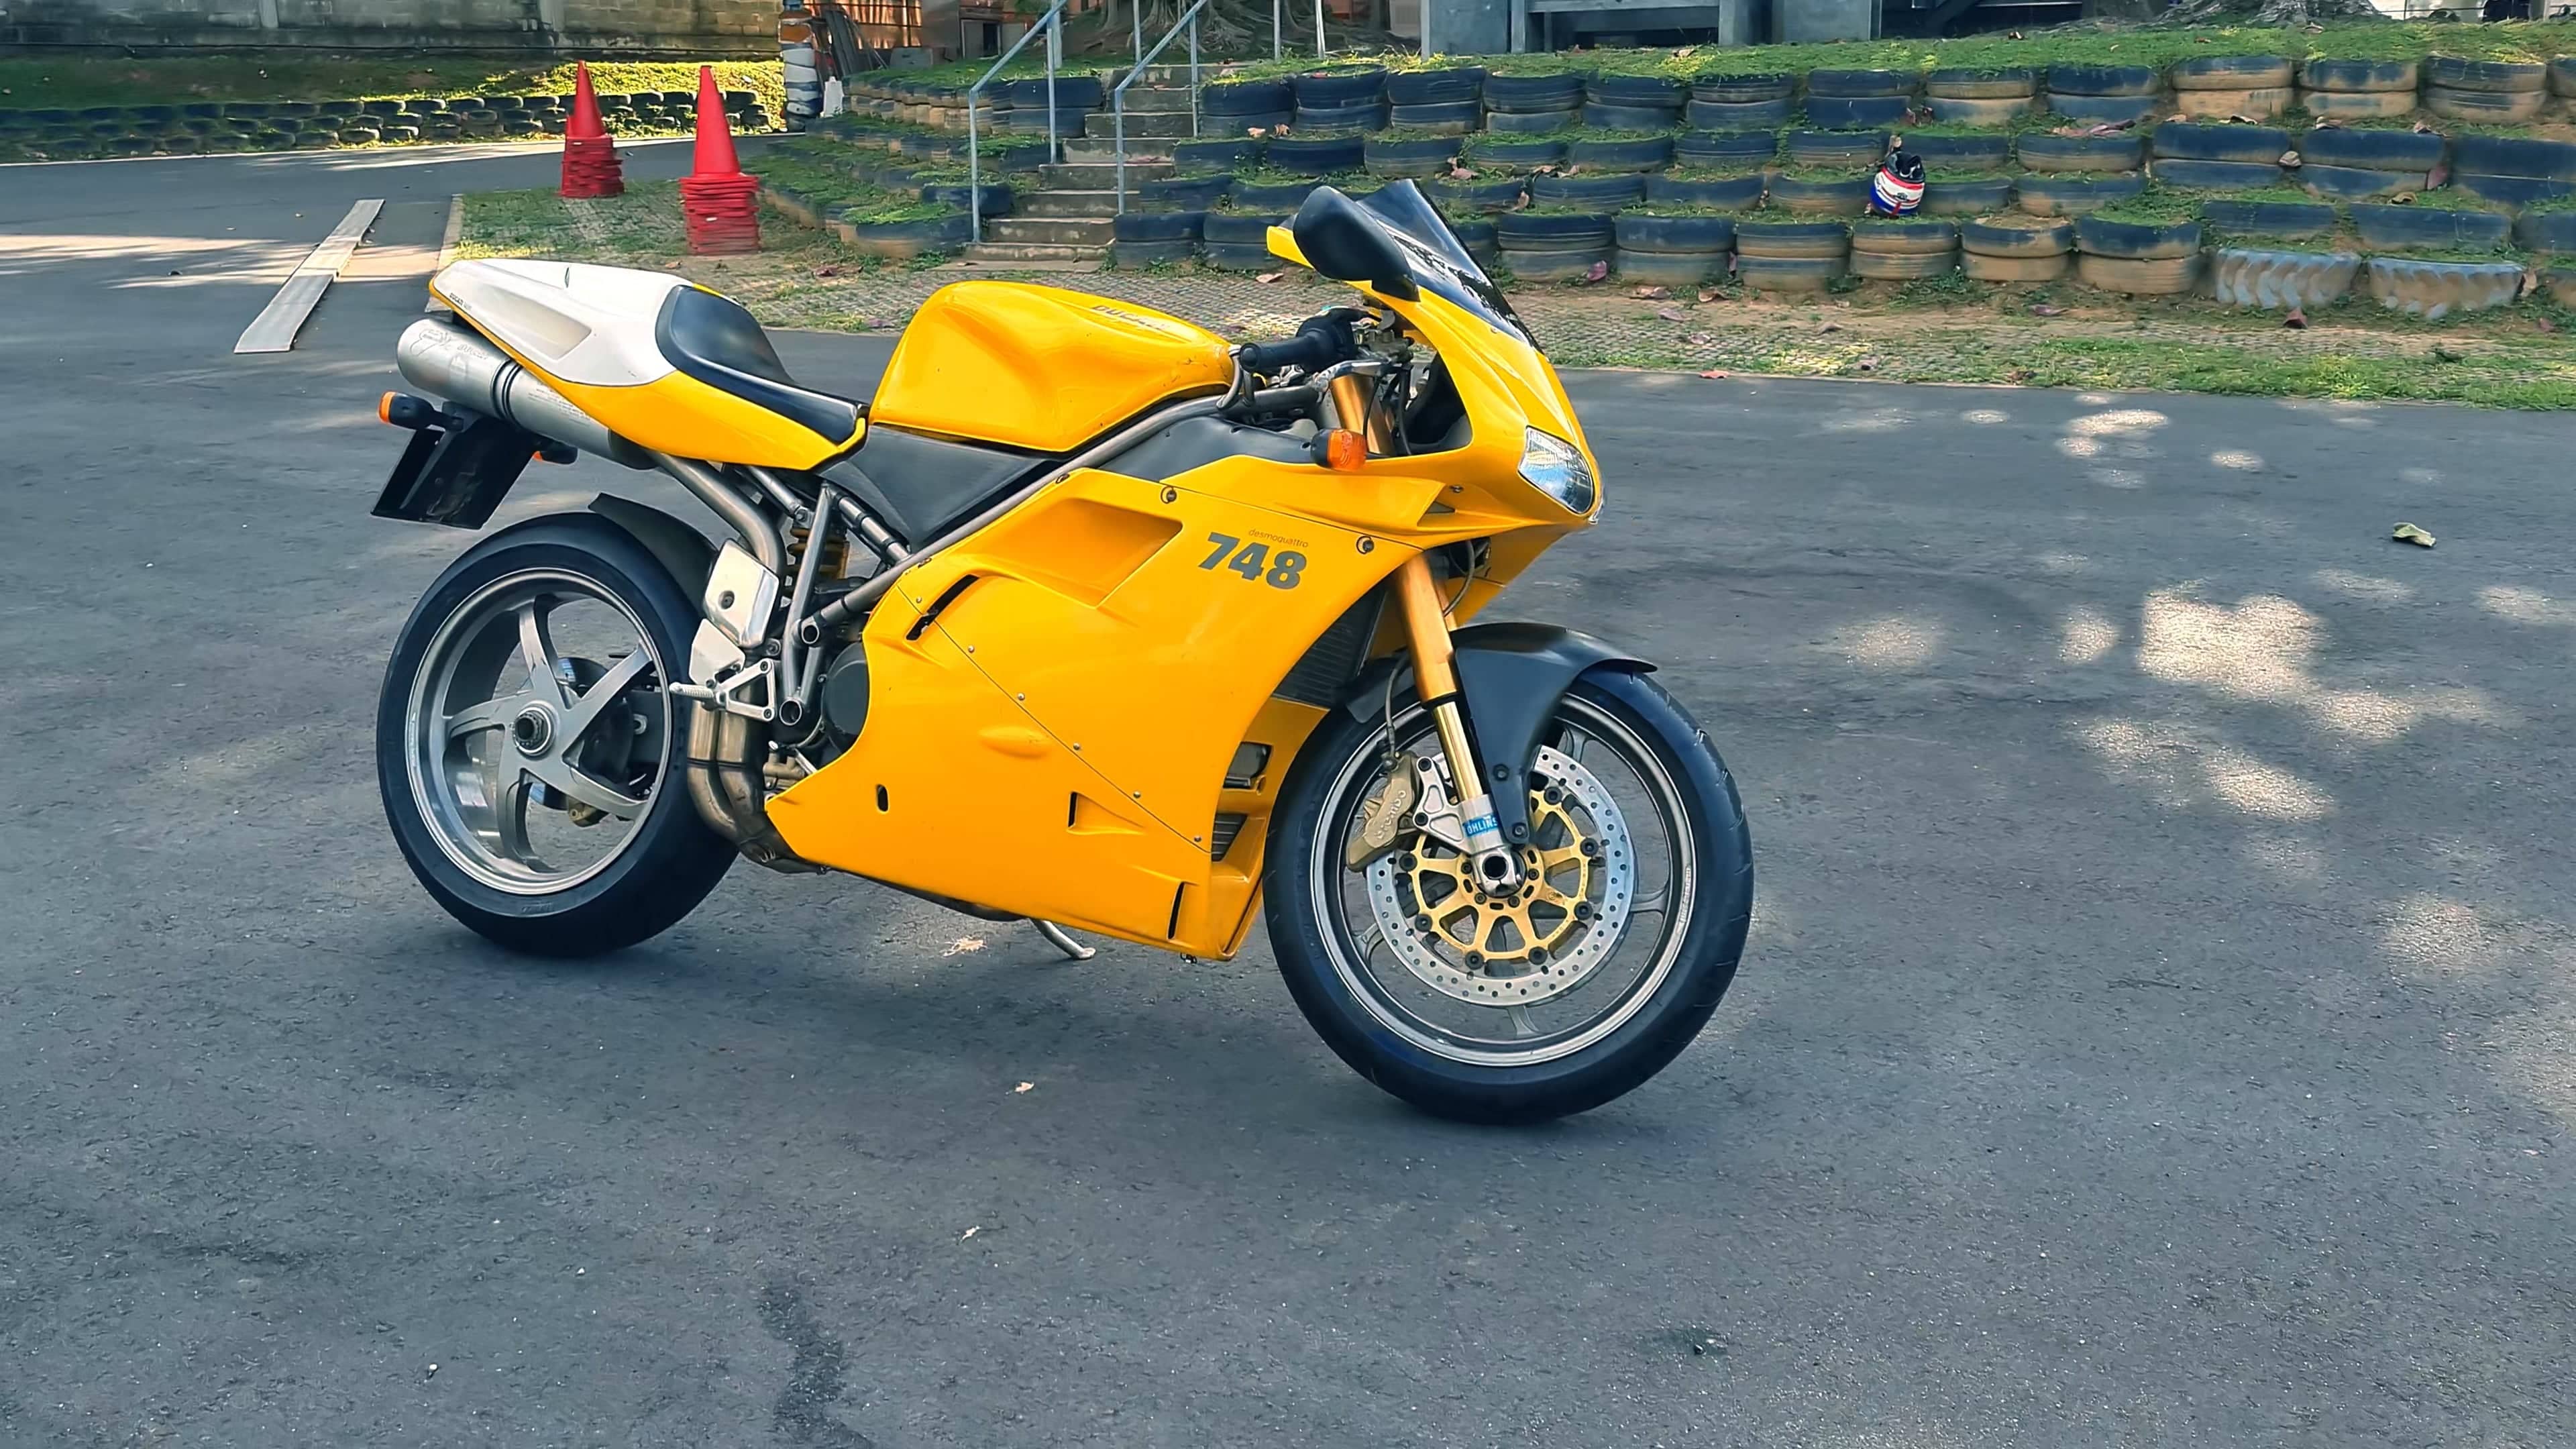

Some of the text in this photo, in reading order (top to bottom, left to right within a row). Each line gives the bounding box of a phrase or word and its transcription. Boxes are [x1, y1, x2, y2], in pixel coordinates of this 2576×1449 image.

[1197, 531, 1307, 590] 748
[1248, 528, 1309, 548] desmoquattro
[1374, 790, 1407, 839] brembo
